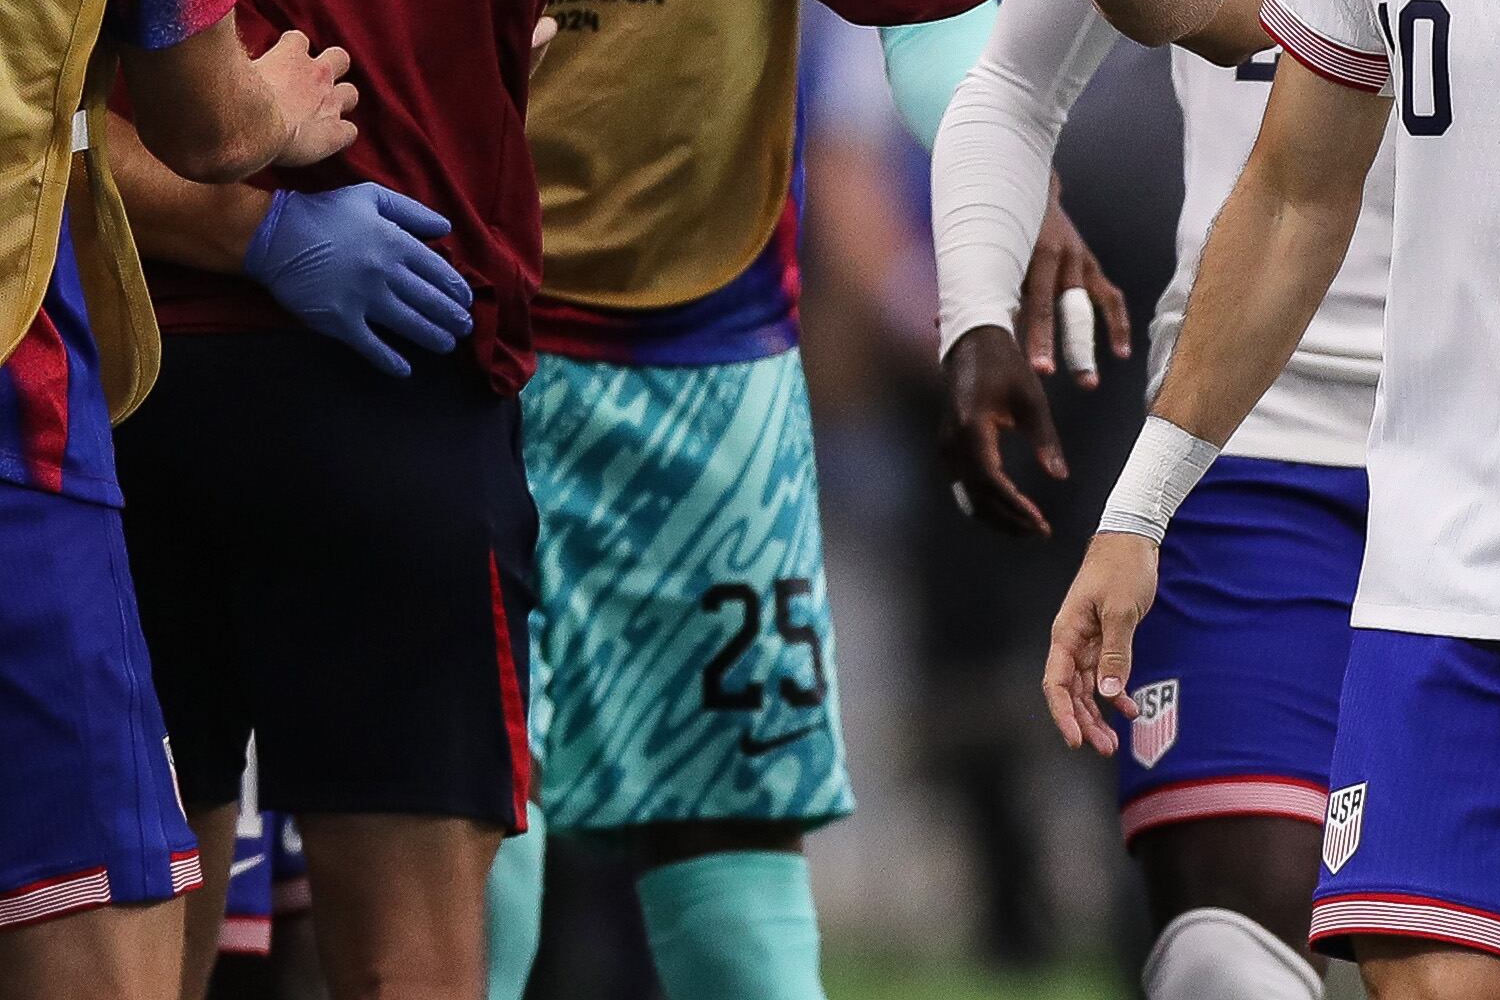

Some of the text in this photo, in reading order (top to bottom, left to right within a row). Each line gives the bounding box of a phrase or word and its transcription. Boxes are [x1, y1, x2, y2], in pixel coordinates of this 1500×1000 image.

[554, 8, 600, 32] 024
[702, 577, 827, 708] 25
[1331, 788, 1363, 824] USA
